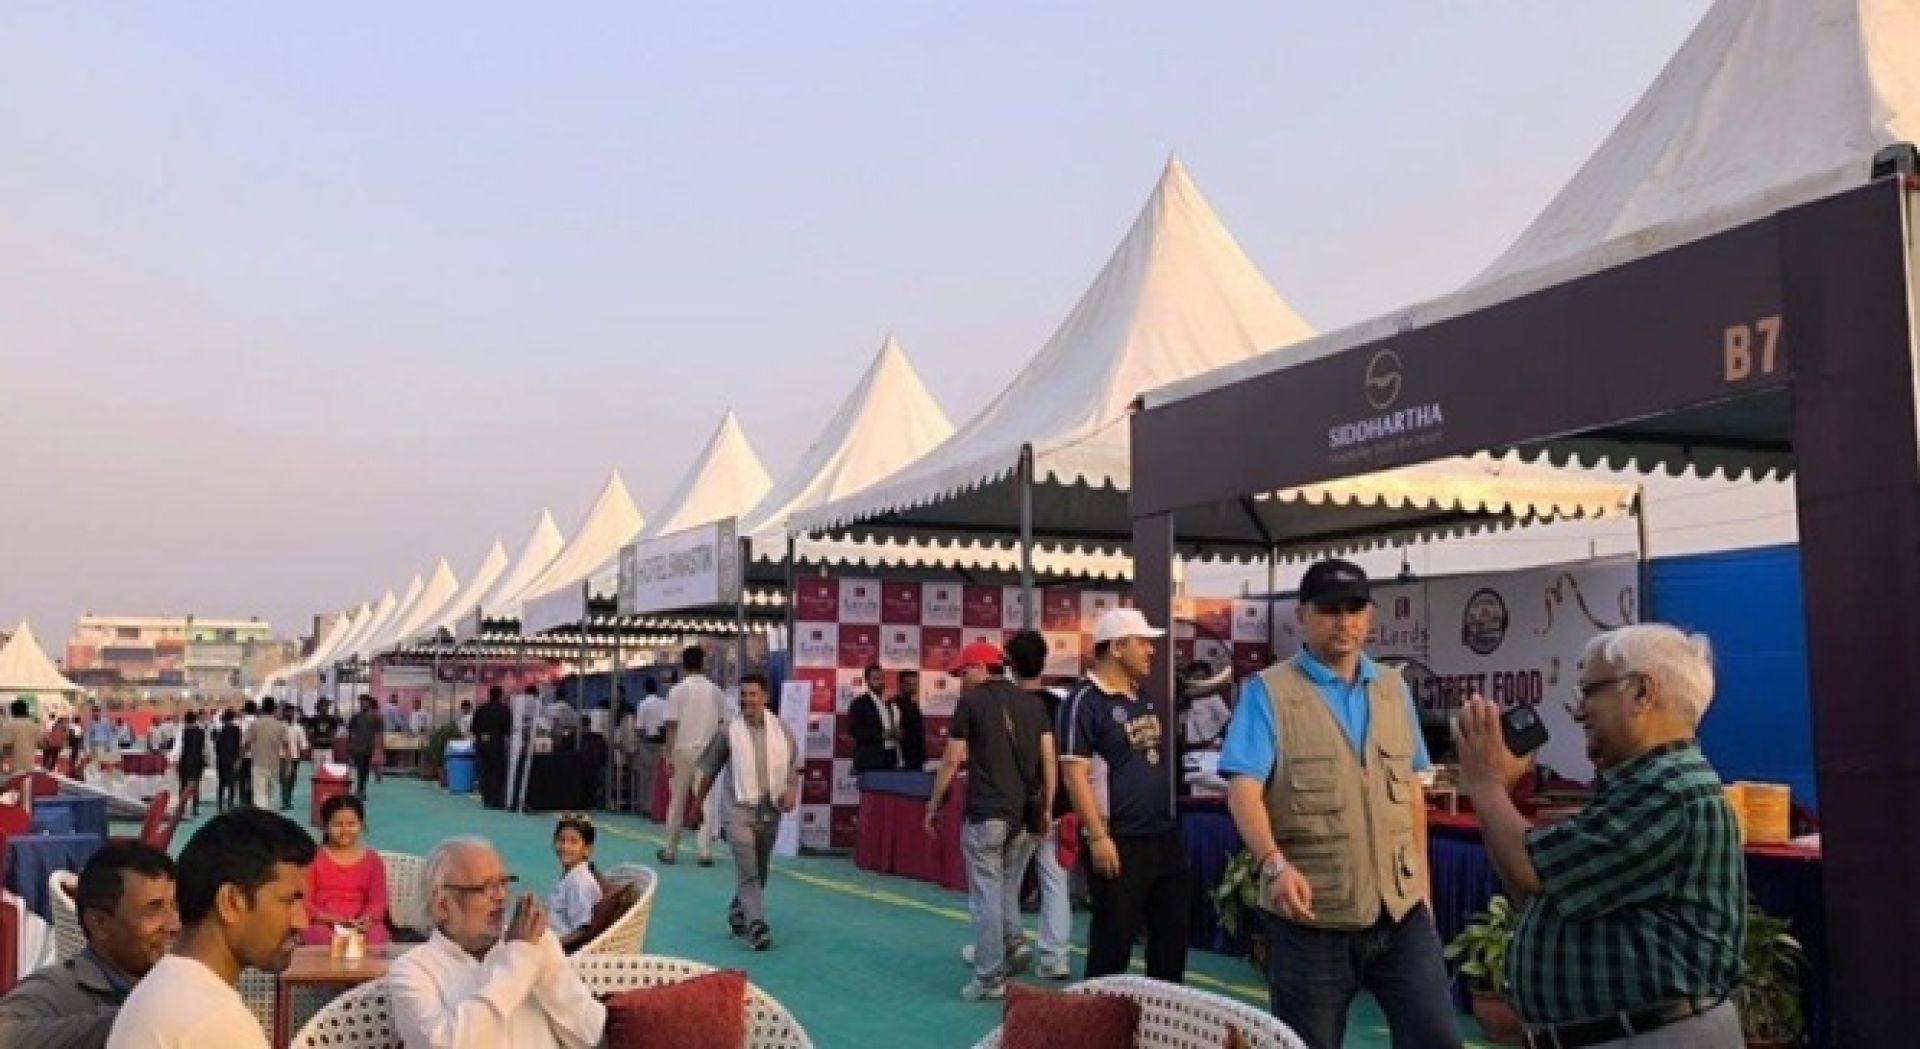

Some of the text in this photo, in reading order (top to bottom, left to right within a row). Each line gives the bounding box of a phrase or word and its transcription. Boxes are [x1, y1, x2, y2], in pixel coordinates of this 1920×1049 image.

[1723, 314, 1781, 381] B7
[1328, 402, 1442, 448] SIDDHARTHA
[1423, 674, 1488, 709] STREET
[1493, 669, 1543, 704] FOOD
